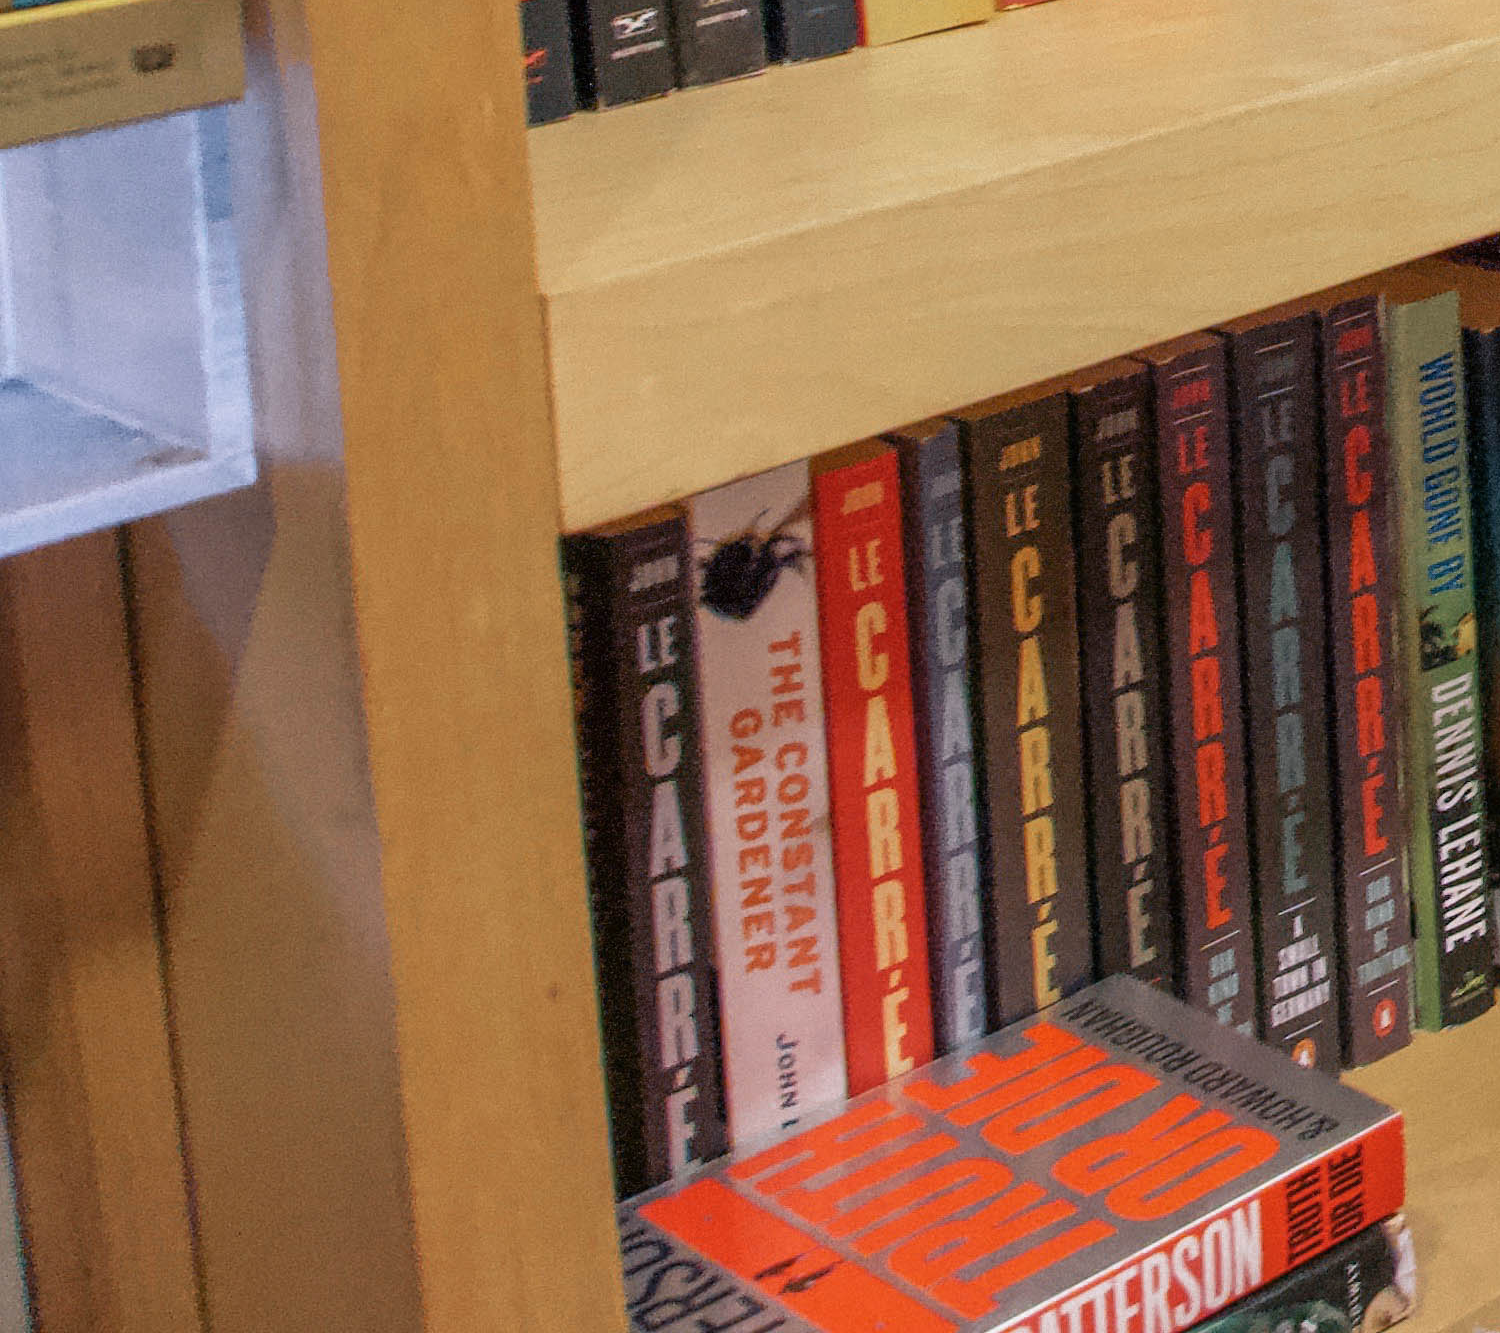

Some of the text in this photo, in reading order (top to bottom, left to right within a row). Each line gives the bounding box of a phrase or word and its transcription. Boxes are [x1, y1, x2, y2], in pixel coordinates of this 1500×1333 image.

[848, 545, 884, 591] LE
[729, 703, 774, 975] GARDENER
[765, 630, 823, 997] THE CONSTANT
[1429, 672, 1487, 954] DENNIS LEHANE
[1285, 1165, 1322, 1266] TRUTH
[1329, 1145, 1364, 1236] OR DIE
[1006, 1197, 1262, 1333] ATTERSON
